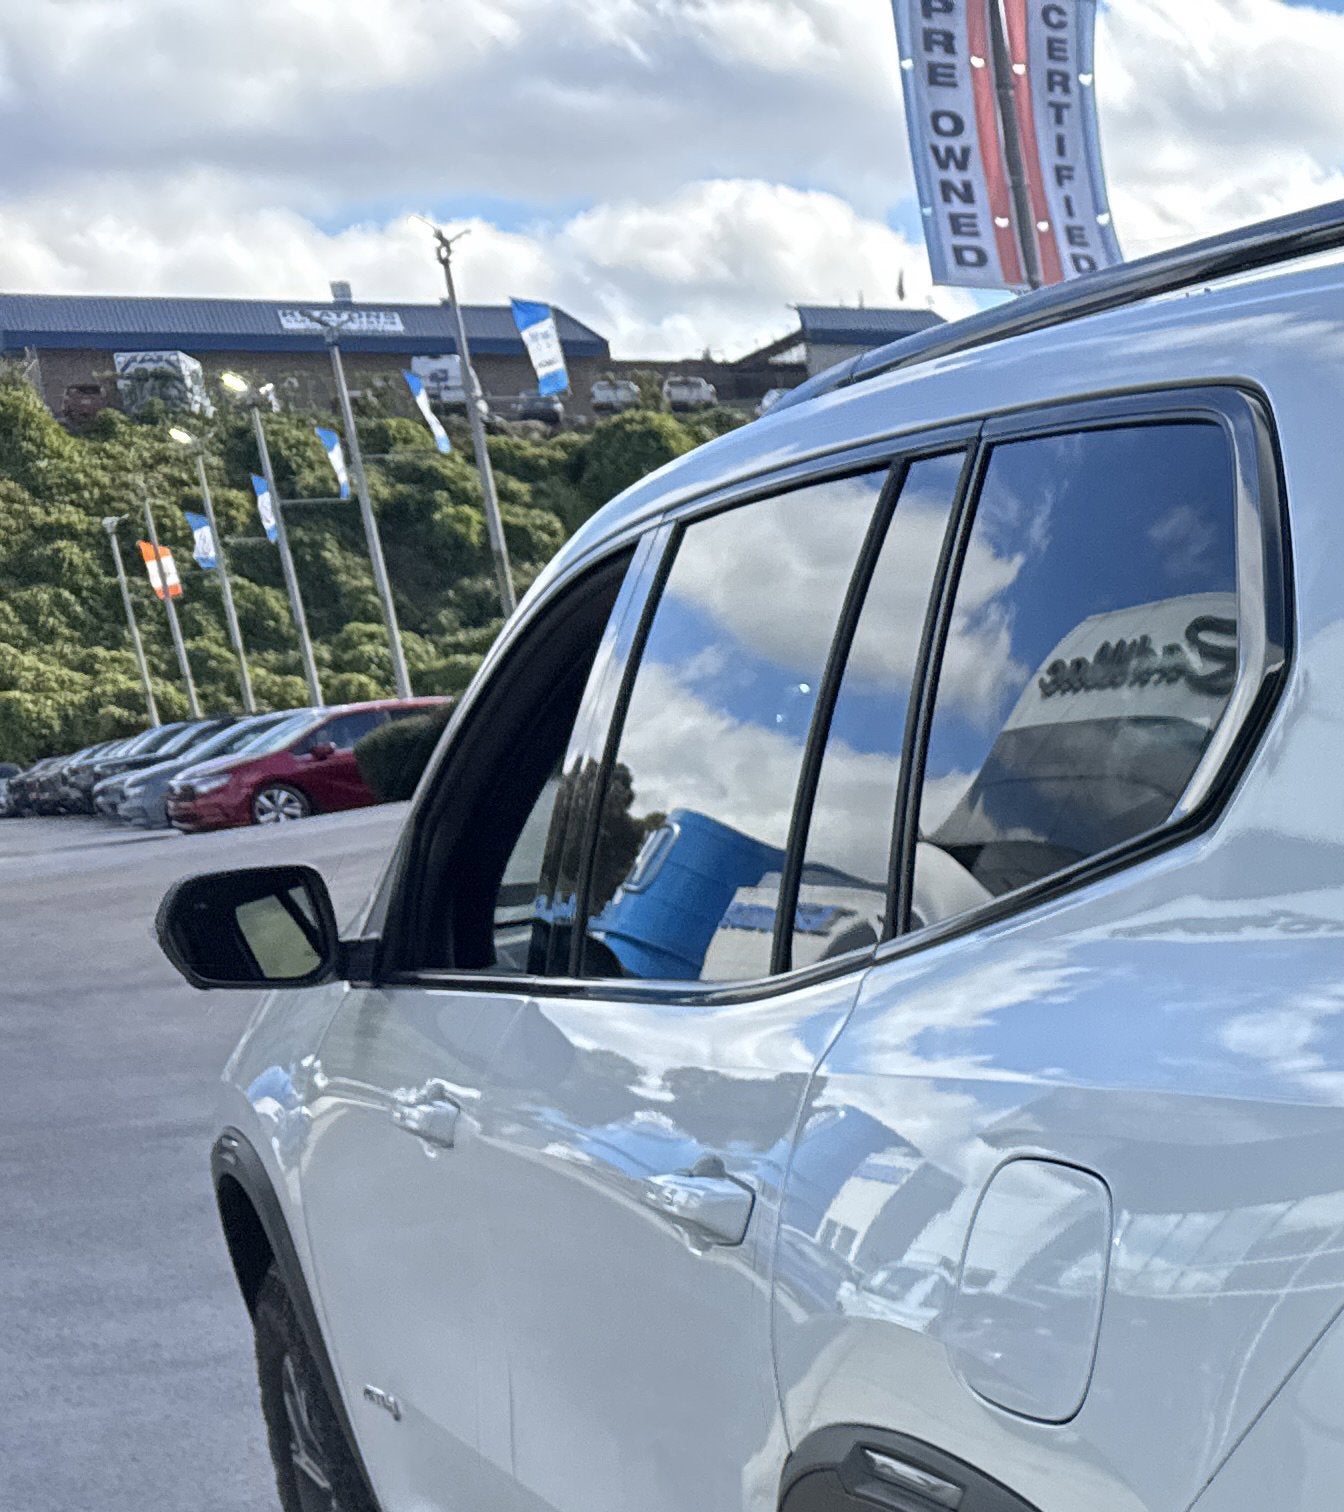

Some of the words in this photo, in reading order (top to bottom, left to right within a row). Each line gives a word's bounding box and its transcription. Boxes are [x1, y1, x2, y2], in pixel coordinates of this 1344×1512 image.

[920, 0, 958, 89] PRE
[929, 110, 989, 268] OWNED
[1041, 4, 1097, 274] CERTIFIED
